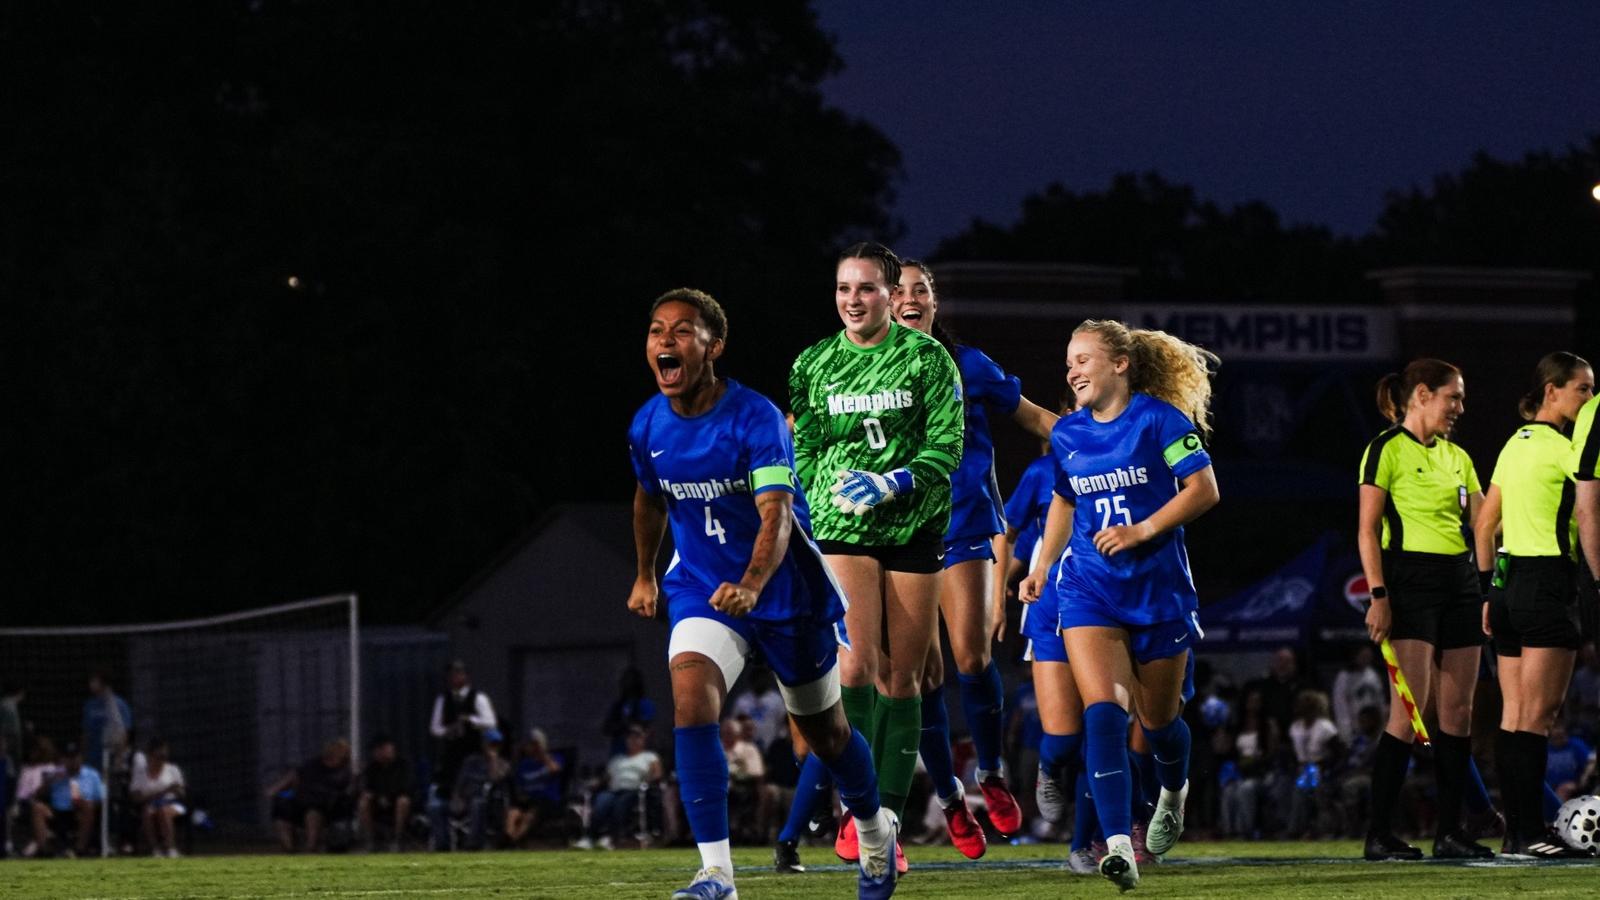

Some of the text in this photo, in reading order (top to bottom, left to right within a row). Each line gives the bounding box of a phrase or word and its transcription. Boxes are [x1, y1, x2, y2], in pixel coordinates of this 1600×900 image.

[827, 389, 912, 416] Memphis
[862, 418, 887, 450] 0
[1183, 435, 1199, 451] C
[658, 477, 748, 503] Memphis
[1068, 466, 1149, 497] Memphis
[704, 505, 728, 546] 4
[1094, 495, 1133, 531] 25
